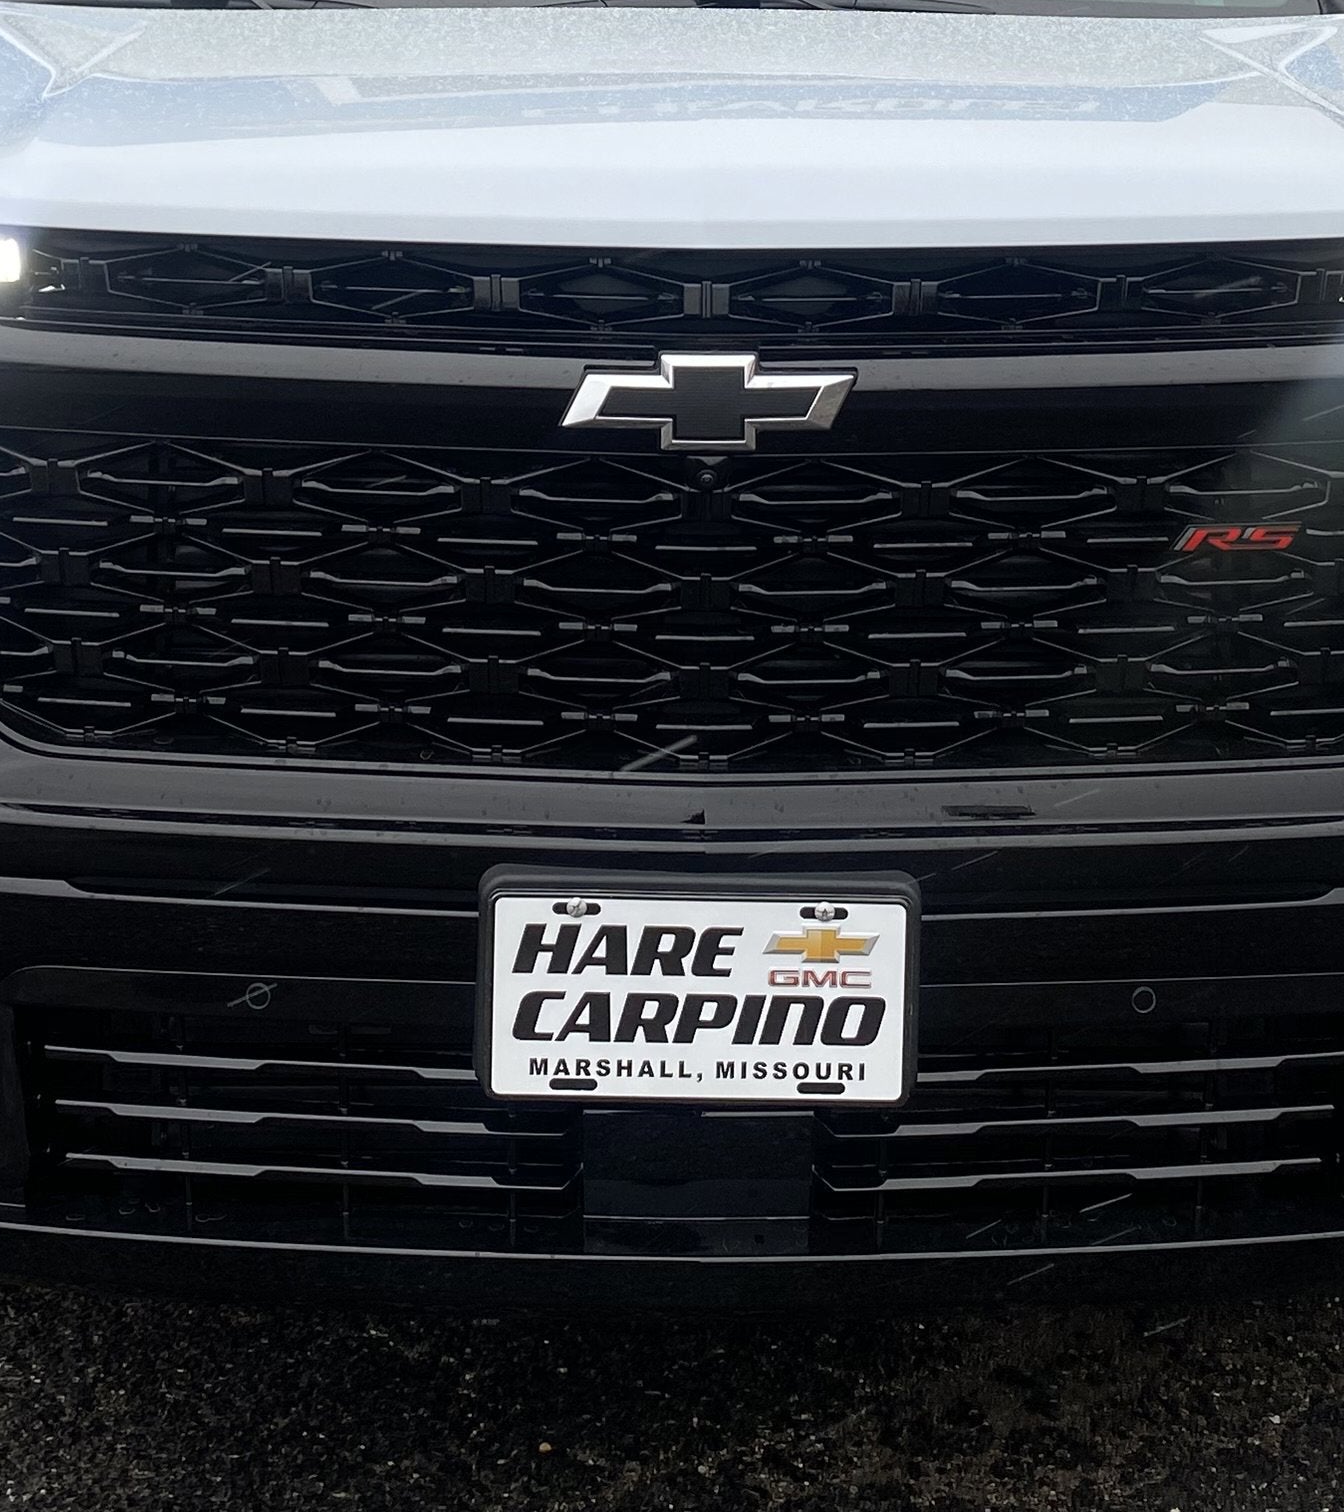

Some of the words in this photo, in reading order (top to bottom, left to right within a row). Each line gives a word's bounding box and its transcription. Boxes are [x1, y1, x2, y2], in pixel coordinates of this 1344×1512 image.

[1174, 522, 1301, 552] RS
[511, 923, 745, 977] HARE
[767, 969, 873, 989] GMC
[511, 990, 887, 1047] CARPINO
[528, 1057, 704, 1083] MARSHALL,
[715, 1060, 866, 1081] MISSOURI
